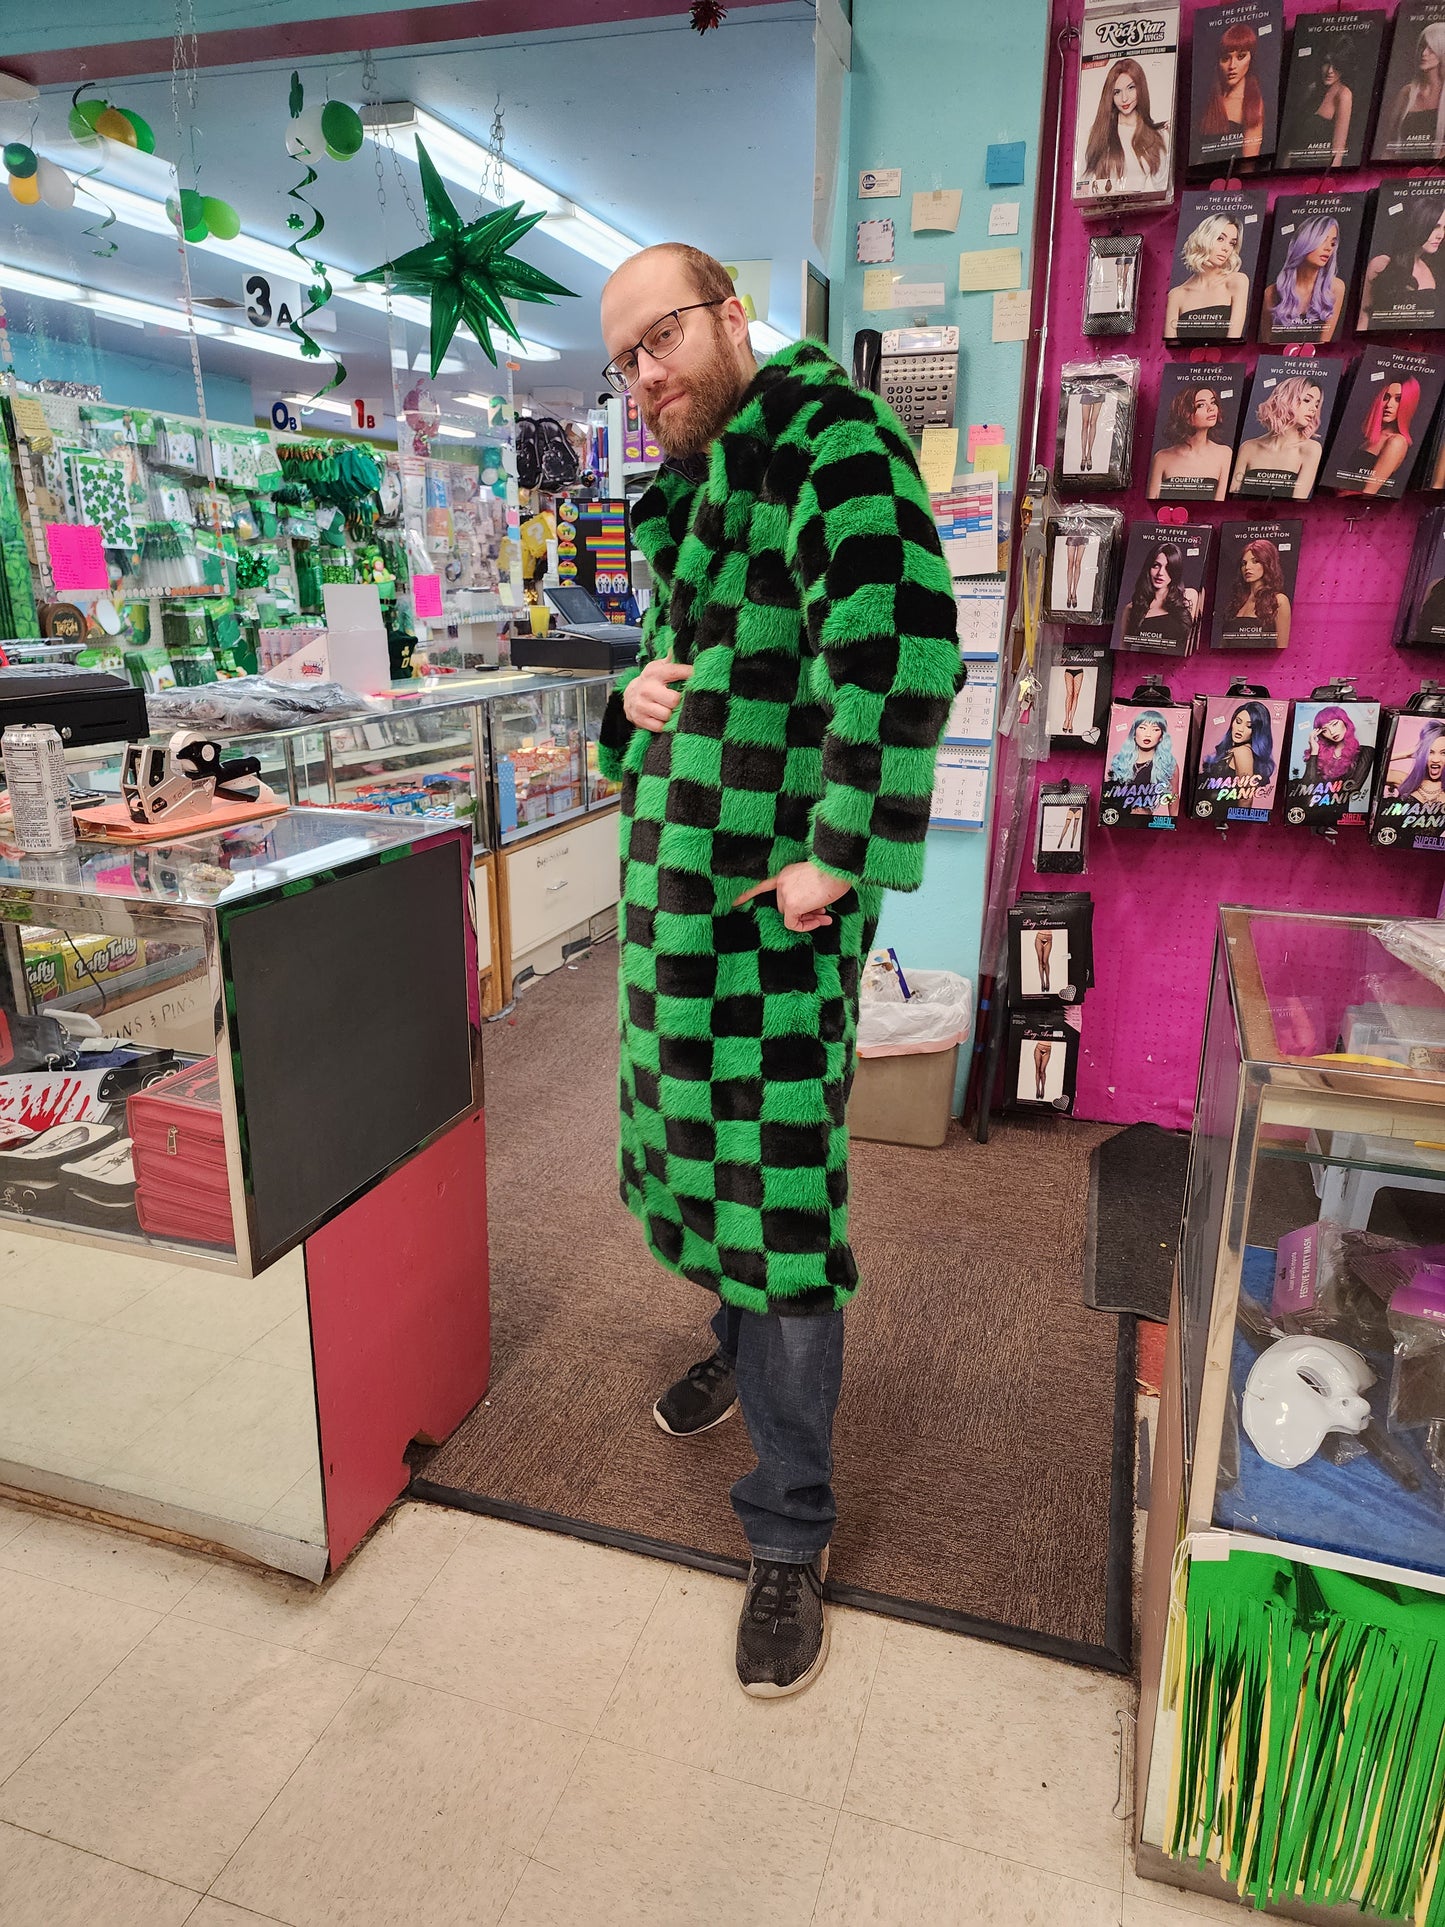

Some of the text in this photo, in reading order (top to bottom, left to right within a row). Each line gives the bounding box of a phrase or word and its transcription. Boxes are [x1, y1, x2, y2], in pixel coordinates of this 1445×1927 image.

[1221, 5, 1257, 17] THE FEVER
[1208, 11, 1270, 27] WIG COLLECTION
[1337, 15, 1359, 23] FEVER
[1324, 24, 1371, 32] COLLECTION
[1220, 132, 1244, 142] ALEXIA
[1406, 356, 1426, 365] FEVER
[1285, 369, 1328, 377] COLLECTION
[1392, 362, 1436, 374] COLLECTION
[1256, 472, 1292, 480] KOURTNEY
[1157, 535, 1198, 544] COLLECTION
[1139, 631, 1163, 639] NICOLE
[1216, 785, 1267, 801] PANIC
[1122, 794, 1172, 809] PANIC
[75, 949, 110, 979] Laffy
[107, 937, 137, 960] Taffy
[1299, 1236, 1312, 1299] FESTIVE PARTY MASK
